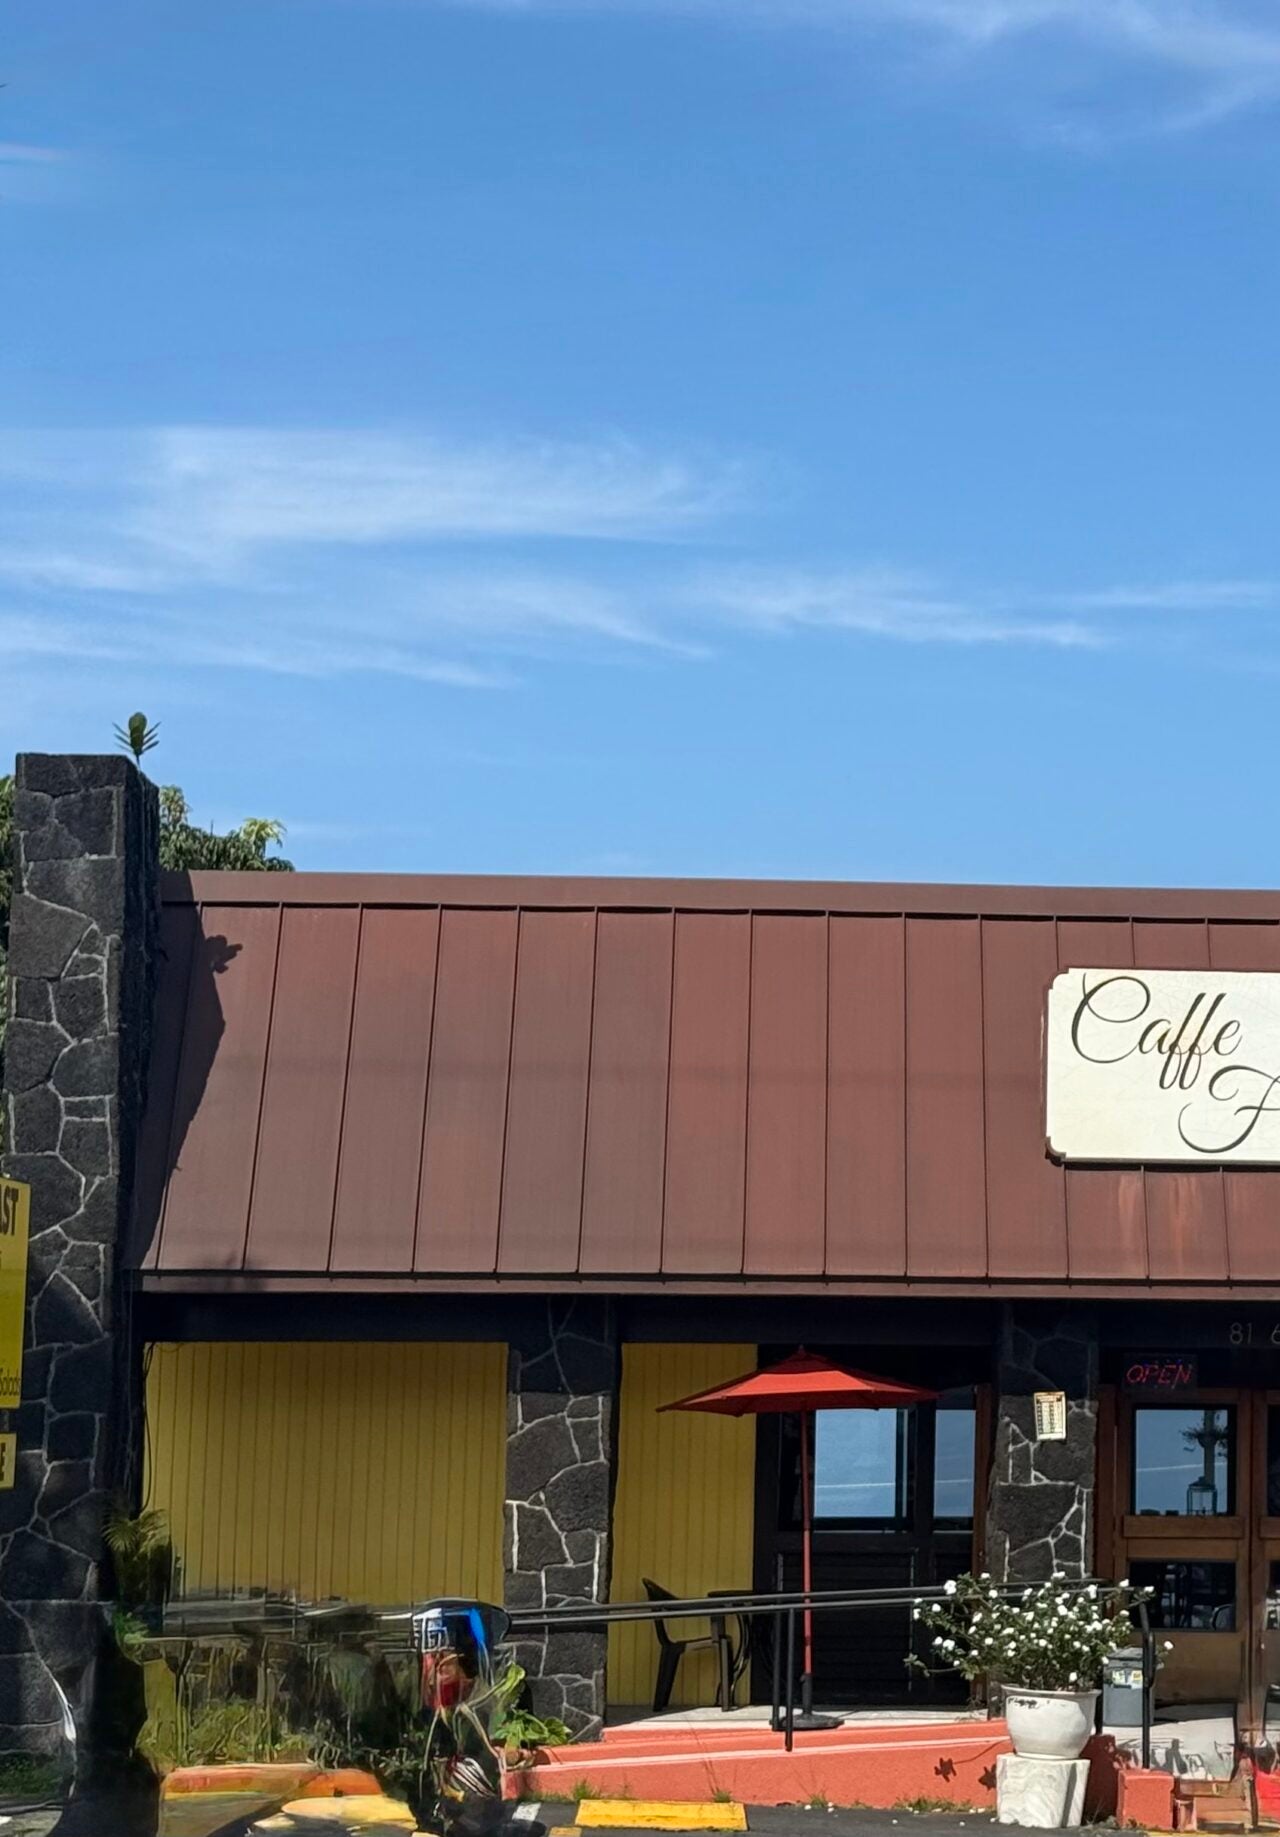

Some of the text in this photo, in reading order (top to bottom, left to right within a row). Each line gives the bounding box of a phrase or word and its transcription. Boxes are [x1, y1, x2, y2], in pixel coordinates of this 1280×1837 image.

[1071, 973, 1242, 1091] Caffe
[0, 1183, 19, 1236] ST
[1230, 1322, 1252, 1344] 81
[1126, 1362, 1192, 1389] OPEN
